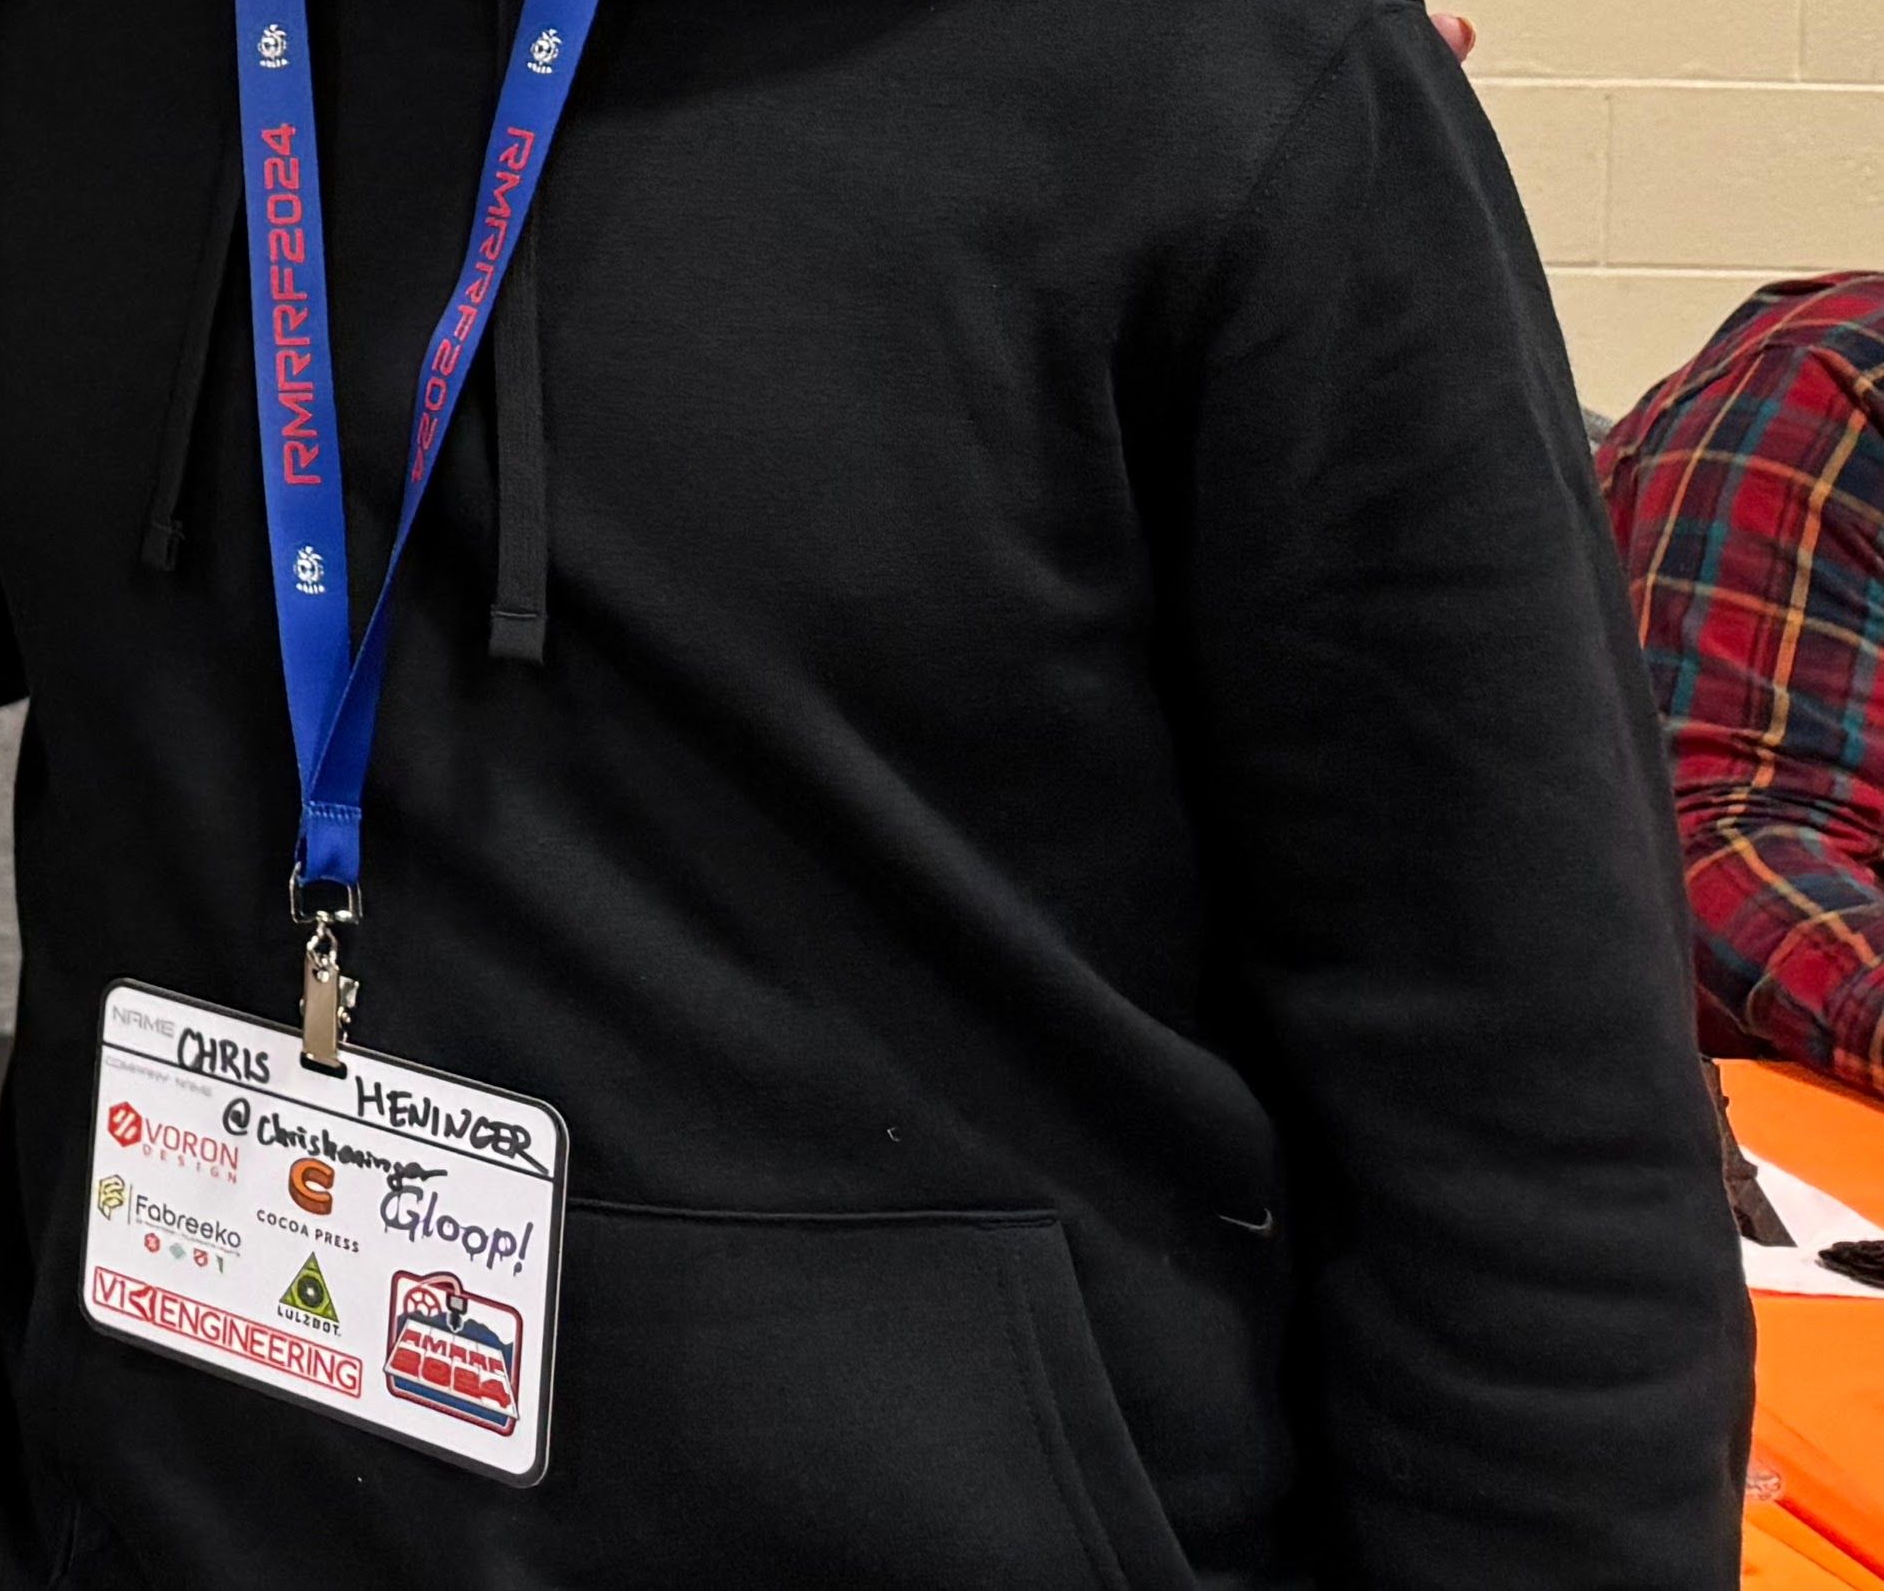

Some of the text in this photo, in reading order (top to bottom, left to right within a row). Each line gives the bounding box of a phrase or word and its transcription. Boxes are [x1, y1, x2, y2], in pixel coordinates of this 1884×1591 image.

[261, 122, 322, 485] RMRRF2024
[411, 126, 535, 484] RMRRF2024
[177, 1027, 271, 1085] CHRIS
[142, 1142, 237, 1184] DESIGN
[145, 1118, 239, 1171] VORON
[135, 1194, 242, 1249] Fabreeko
[256, 1209, 310, 1238] COCOA
[314, 1228, 360, 1253] PRESS
[380, 1184, 534, 1277] Gloop!
[159, 1292, 358, 1391] ENGINEERING
